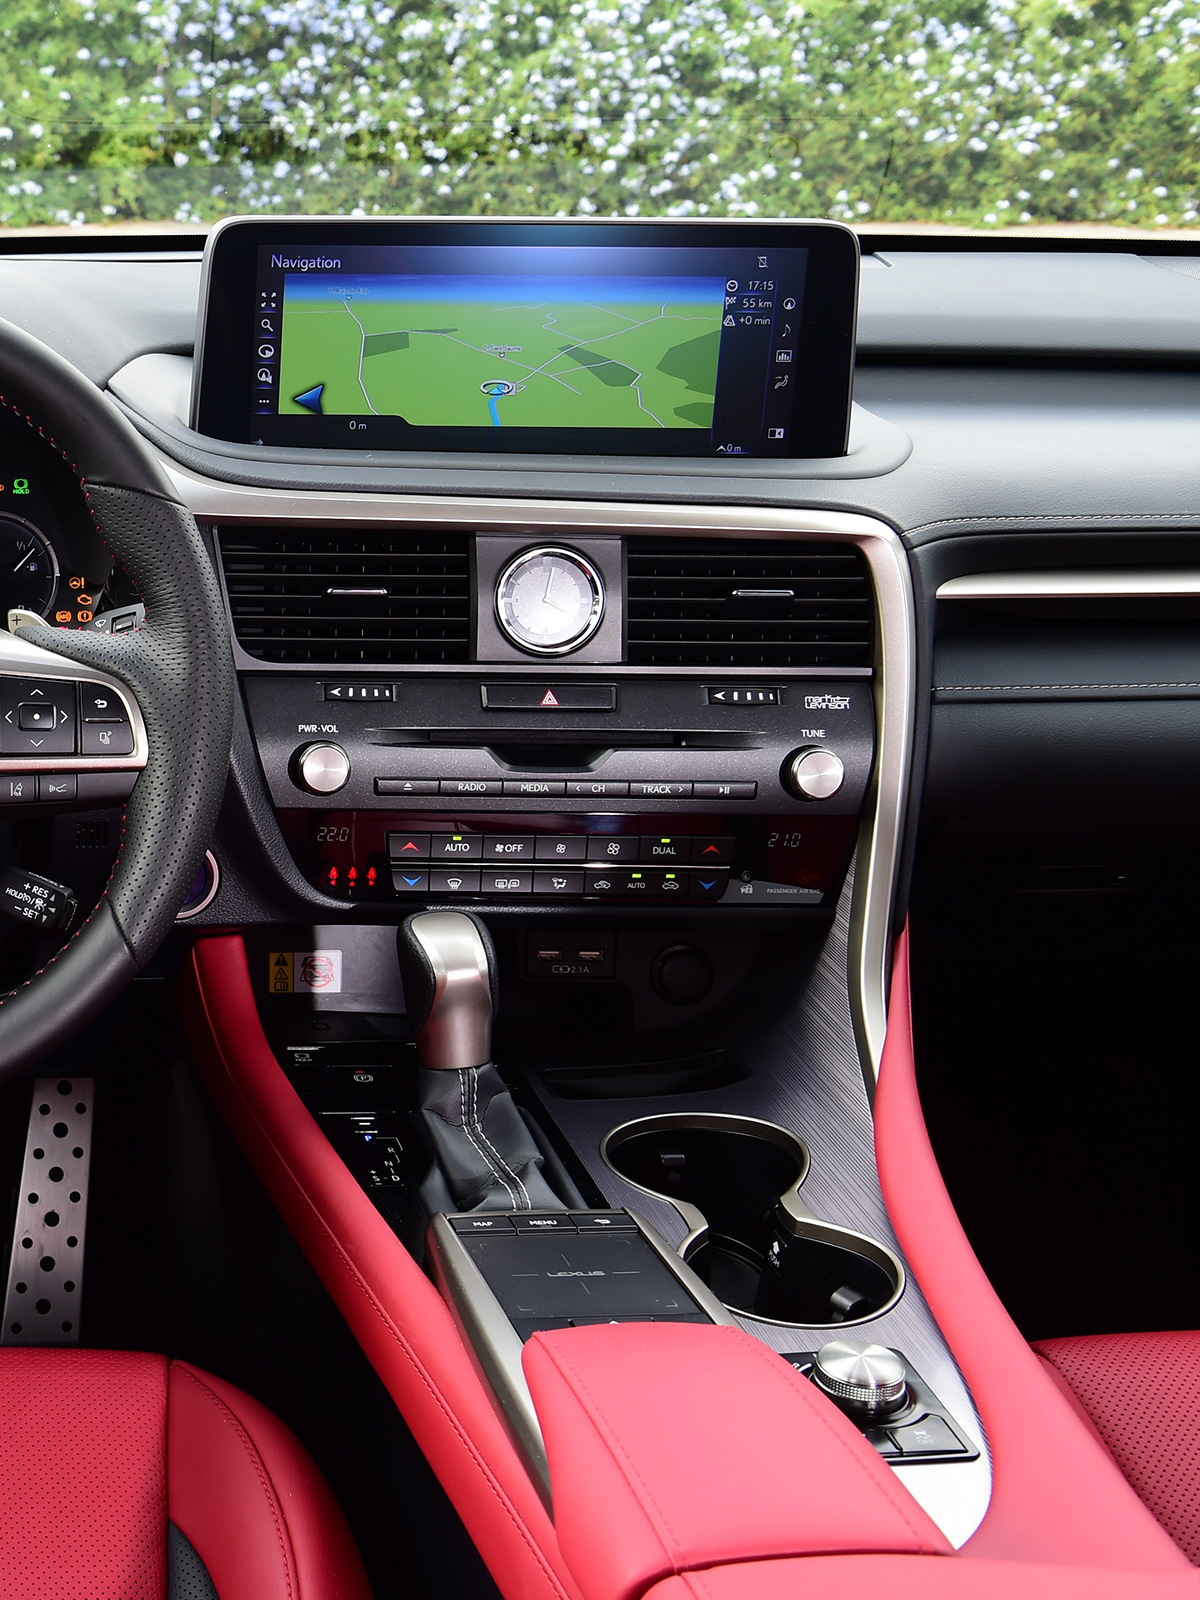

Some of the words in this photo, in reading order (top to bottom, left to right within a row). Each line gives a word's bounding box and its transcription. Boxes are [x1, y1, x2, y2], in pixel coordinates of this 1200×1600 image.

[271, 254, 341, 272] Navigation
[748, 280, 774, 291] 17:15
[742, 298, 756, 308] 55
[758, 299, 772, 308] km
[739, 315, 753, 325] +0
[754, 316, 771, 325] min
[349, 420, 357, 430] 0
[726, 443, 733, 452] 0
[800, 729, 826, 738] TUNE
[457, 783, 487, 792] RADIO
[520, 784, 549, 792] MEDIA
[591, 784, 606, 793] CH
[642, 785, 672, 794] TRACK
[317, 827, 350, 842] 22.0
[767, 832, 802, 848] 21.0
[444, 843, 470, 852] AUTO
[504, 844, 524, 853] OFF
[652, 846, 677, 855] DUAL
[5, 887, 24, 900] HOLD
[22, 907, 40, 920] SET
[364, 1134, 373, 1142] P
[391, 1174, 400, 1182] D
